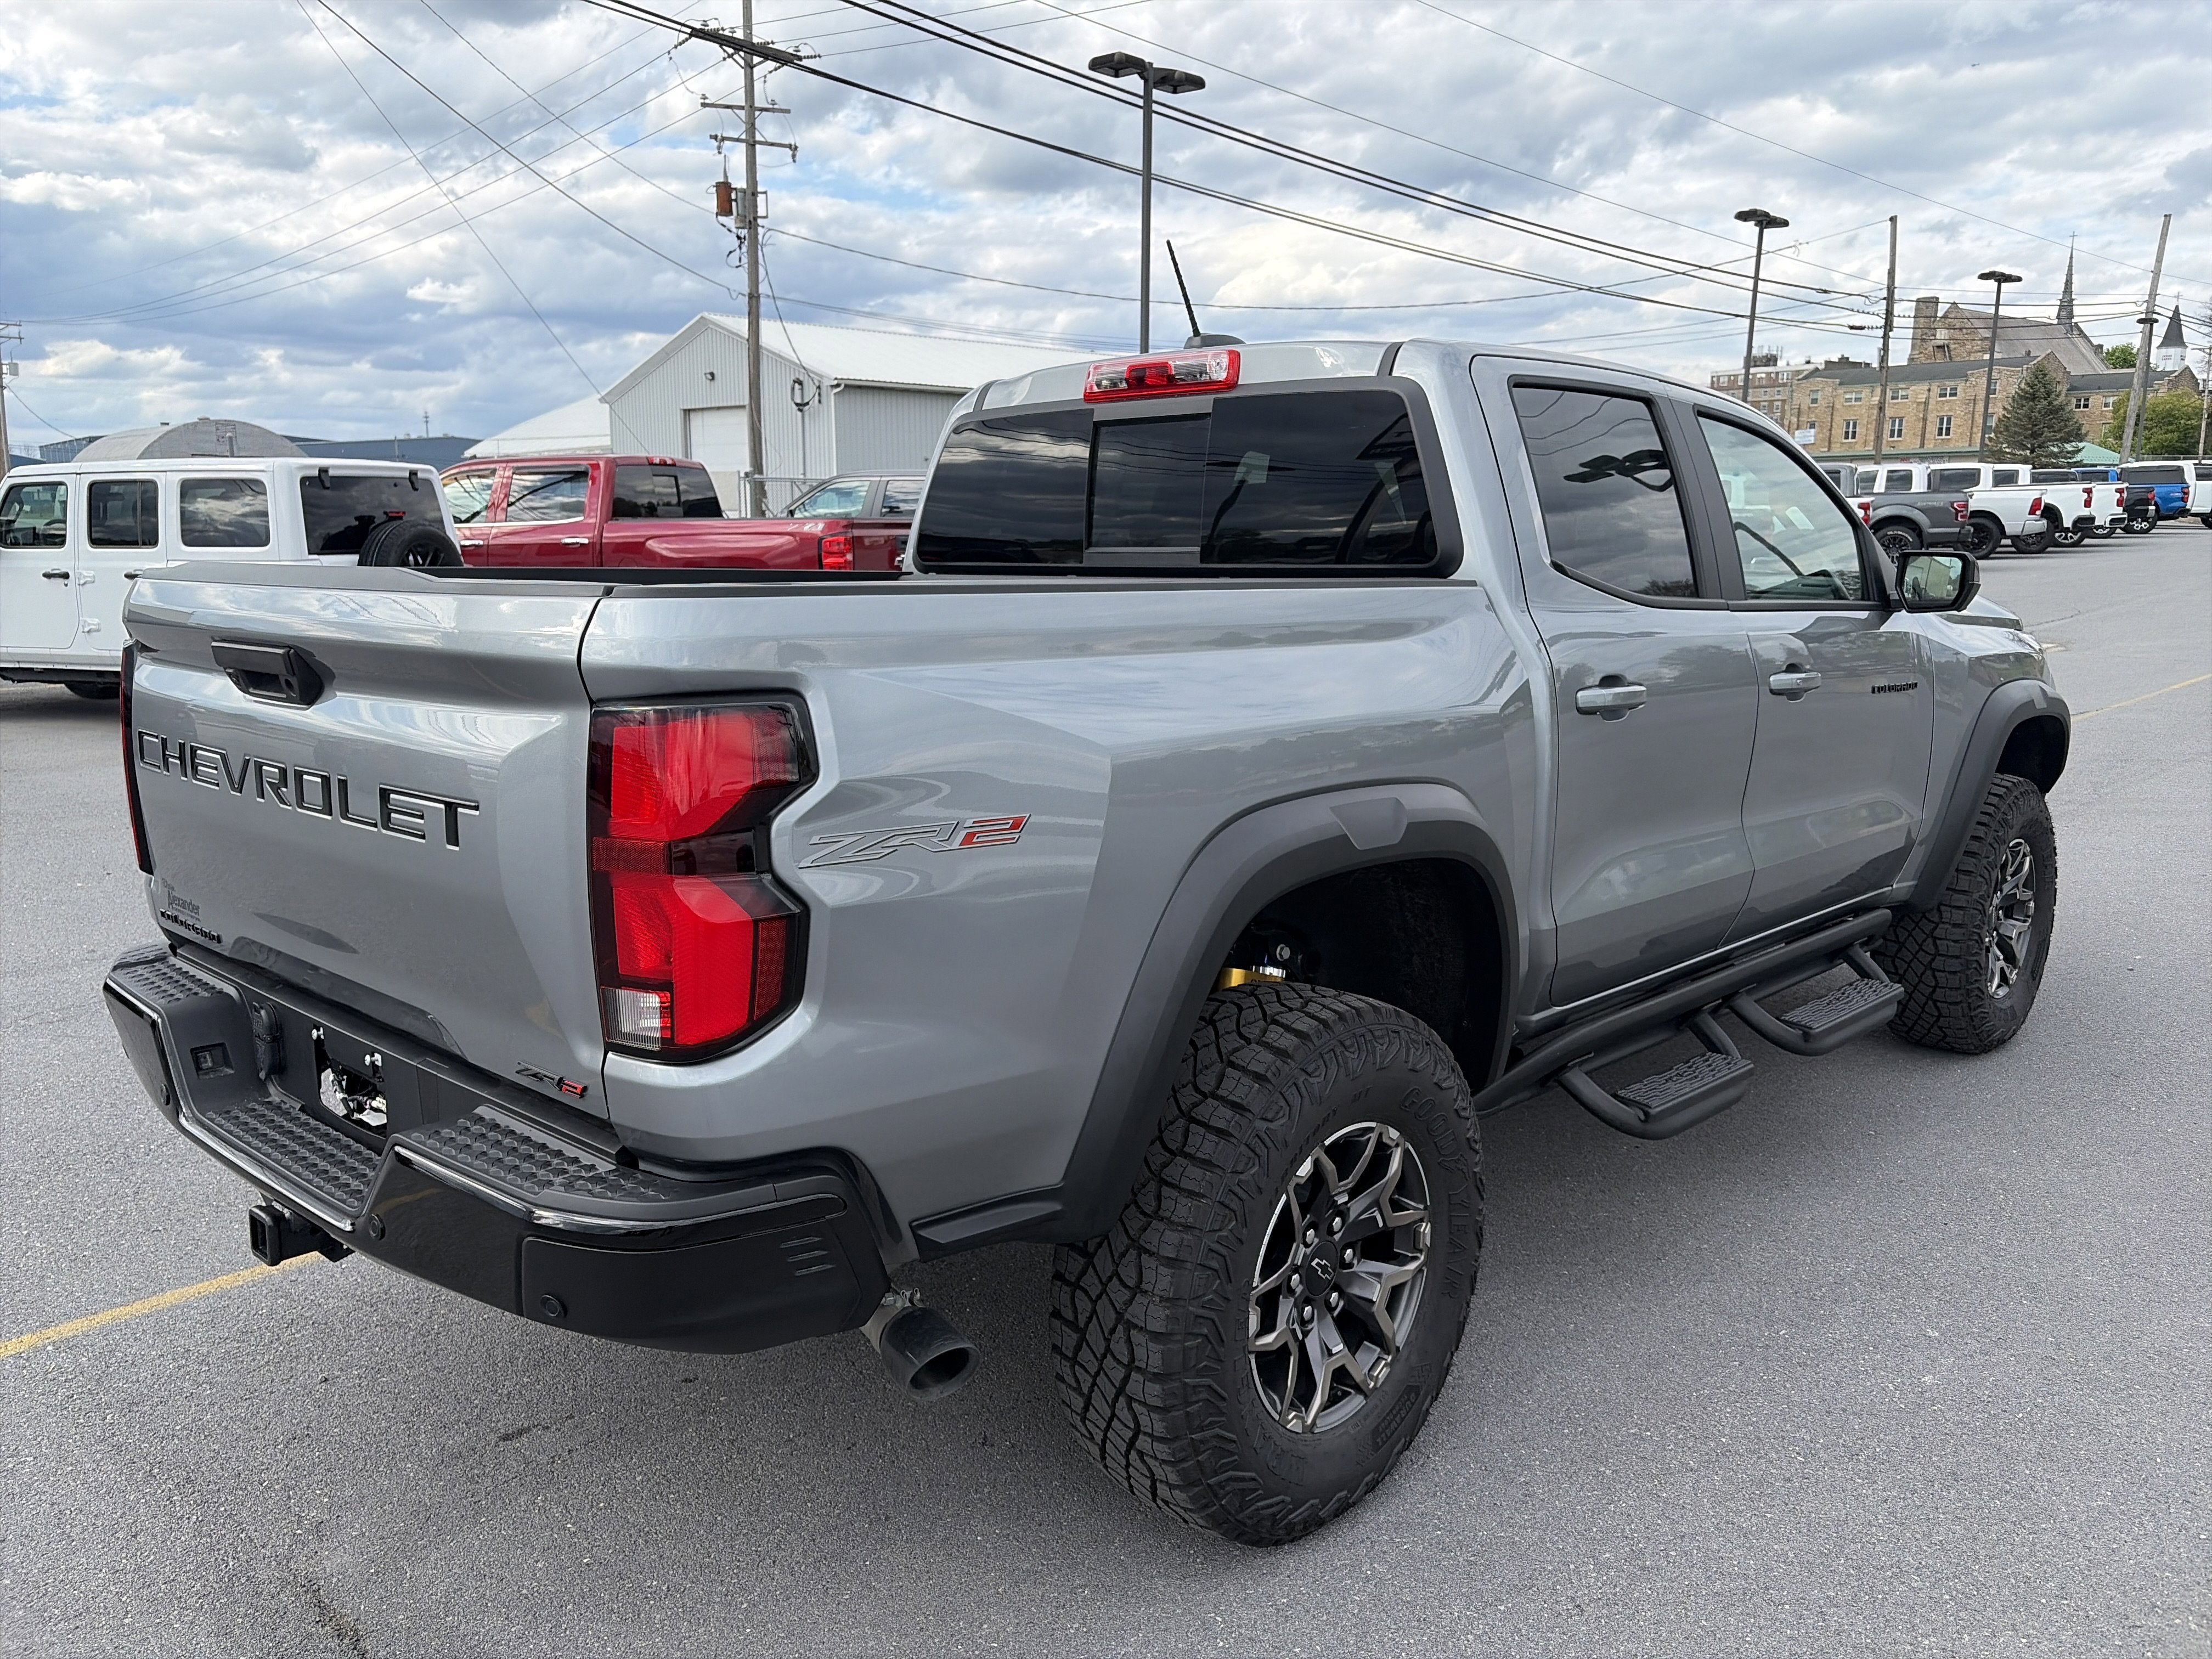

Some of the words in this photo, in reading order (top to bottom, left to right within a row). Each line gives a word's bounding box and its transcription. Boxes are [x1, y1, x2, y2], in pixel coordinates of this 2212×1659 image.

[137, 729, 479, 851] CHEVROLET
[798, 813, 1031, 869] ZR2
[159, 908, 222, 944] COLORADO
[167, 889, 200, 916] Alexander
[515, 1061, 588, 1099] ZR2
[1400, 1086, 1472, 1300] GOODYEAR
